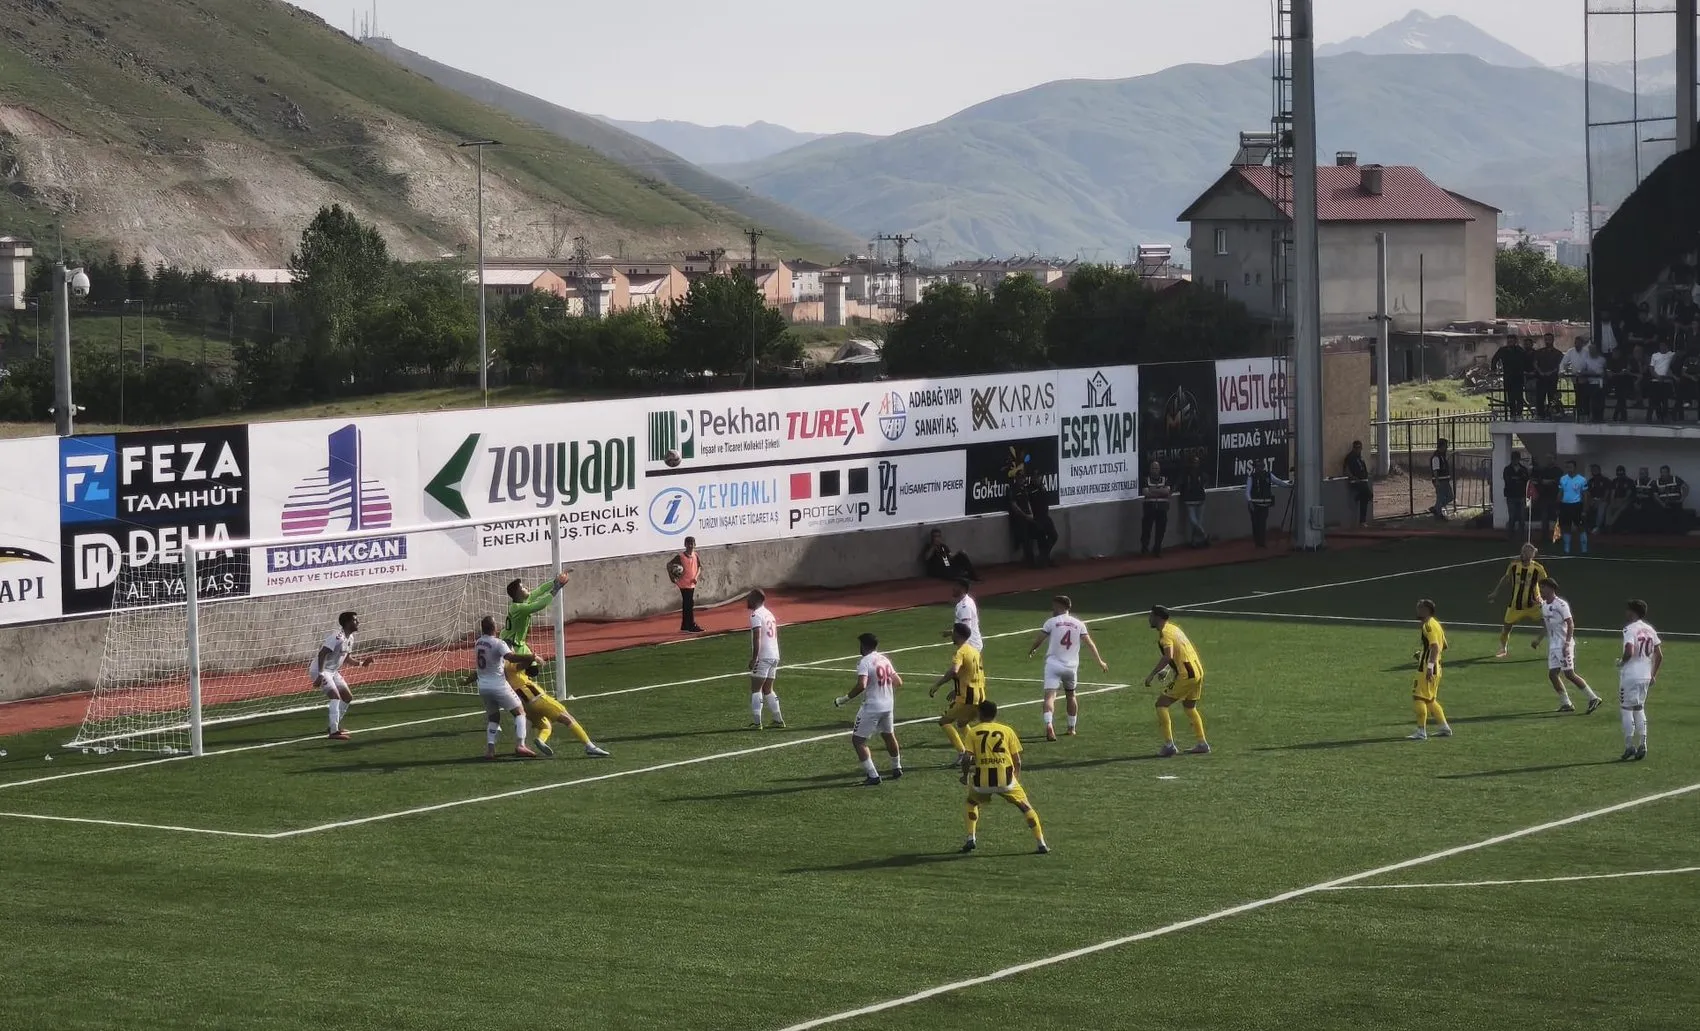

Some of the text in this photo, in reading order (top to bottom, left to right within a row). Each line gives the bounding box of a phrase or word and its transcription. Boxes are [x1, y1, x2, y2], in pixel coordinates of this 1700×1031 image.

[944, 388, 961, 405] YAPI
[999, 382, 1055, 413] KARAS
[700, 407, 779, 436] Pekhan
[786, 402, 870, 445] TUREX
[915, 414, 944, 436] SANAYİ
[1061, 412, 1136, 458] ESER YAPI
[1221, 428, 1261, 449] MEDAĞ
[122, 441, 242, 485] FEZA
[1234, 456, 1275, 476] İNŞAT
[698, 478, 777, 510] ZEYDANLI
[943, 480, 963, 491] PEKER
[123, 486, 242, 512] TAAHHÜT
[789, 504, 843, 529] PROTEK
[129, 523, 234, 567] DEHA
[483, 529, 539, 547] ENERJİ
[274, 539, 399, 569] BURAKCAN
[267, 575, 303, 586] İNŞAAT
[307, 574, 320, 582] VE
[323, 568, 366, 580] TİCARET
[127, 581, 160, 600] ALT
[1060, 629, 1072, 650] 4
[477, 648, 487, 670] 6
[976, 730, 1006, 754] 72
